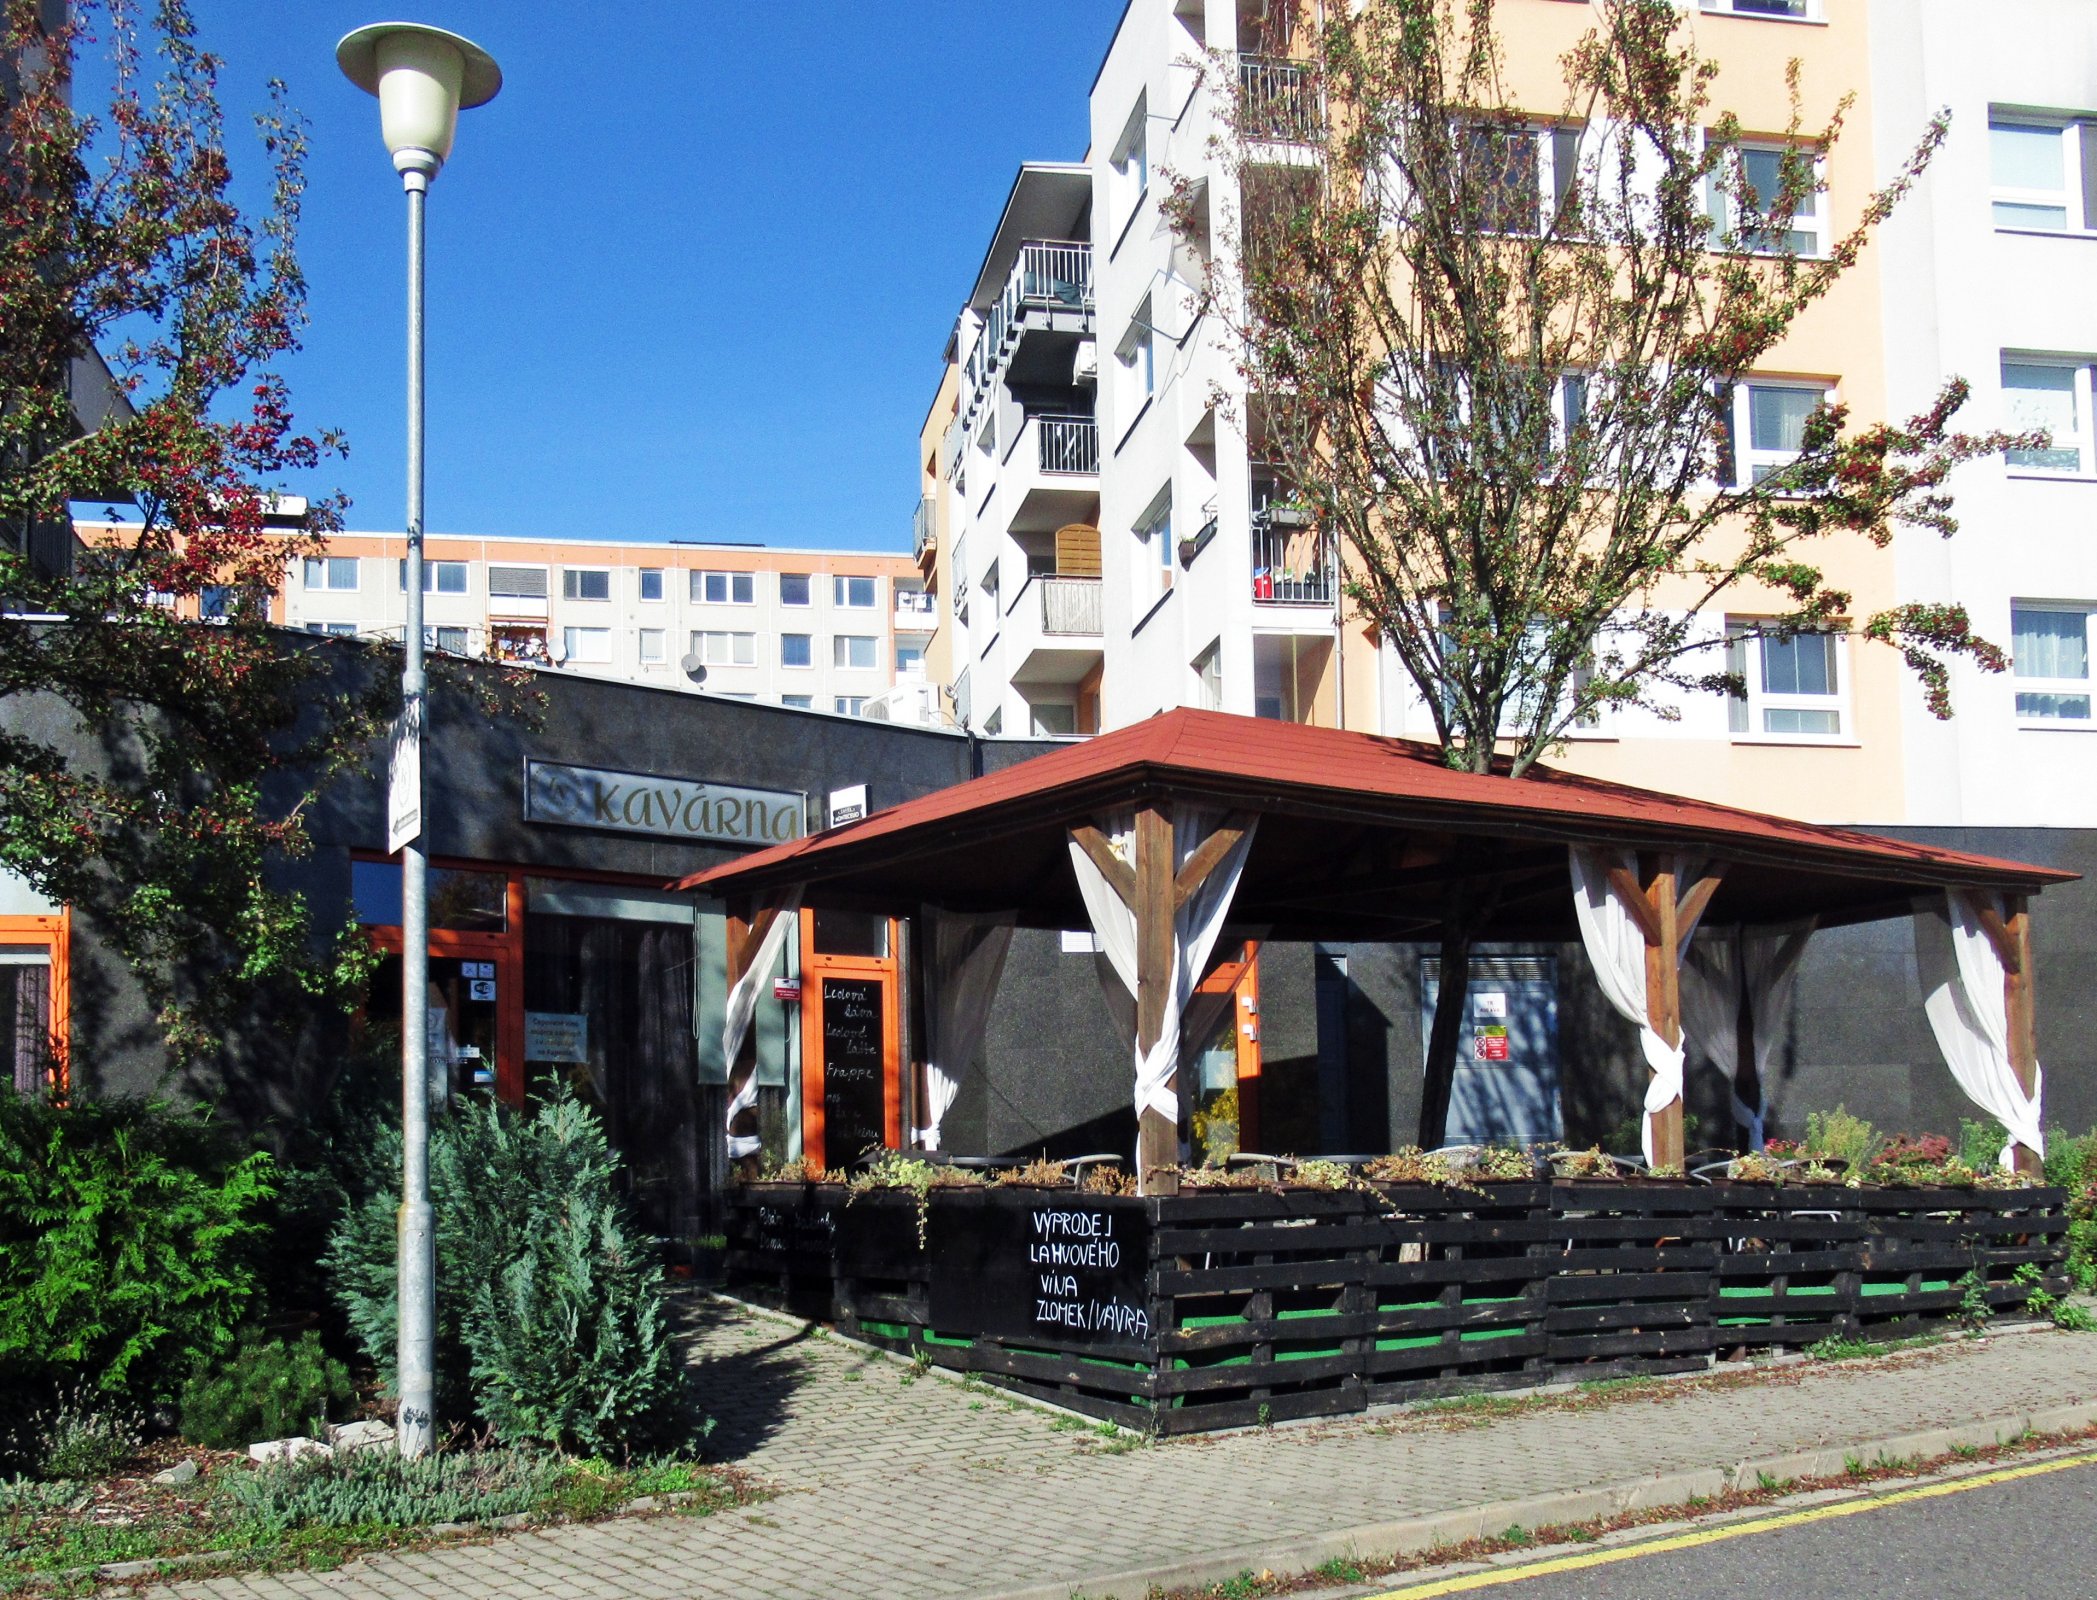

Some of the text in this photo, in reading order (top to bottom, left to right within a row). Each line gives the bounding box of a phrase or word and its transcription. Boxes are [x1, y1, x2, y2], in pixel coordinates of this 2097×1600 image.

[824, 985, 867, 1000] Ledová
[1033, 1207, 1111, 1241] VÝPRODEJ
[1030, 1237, 1119, 1268] LAHVOVÉHO
[1041, 1269, 1078, 1297] VÍNA
